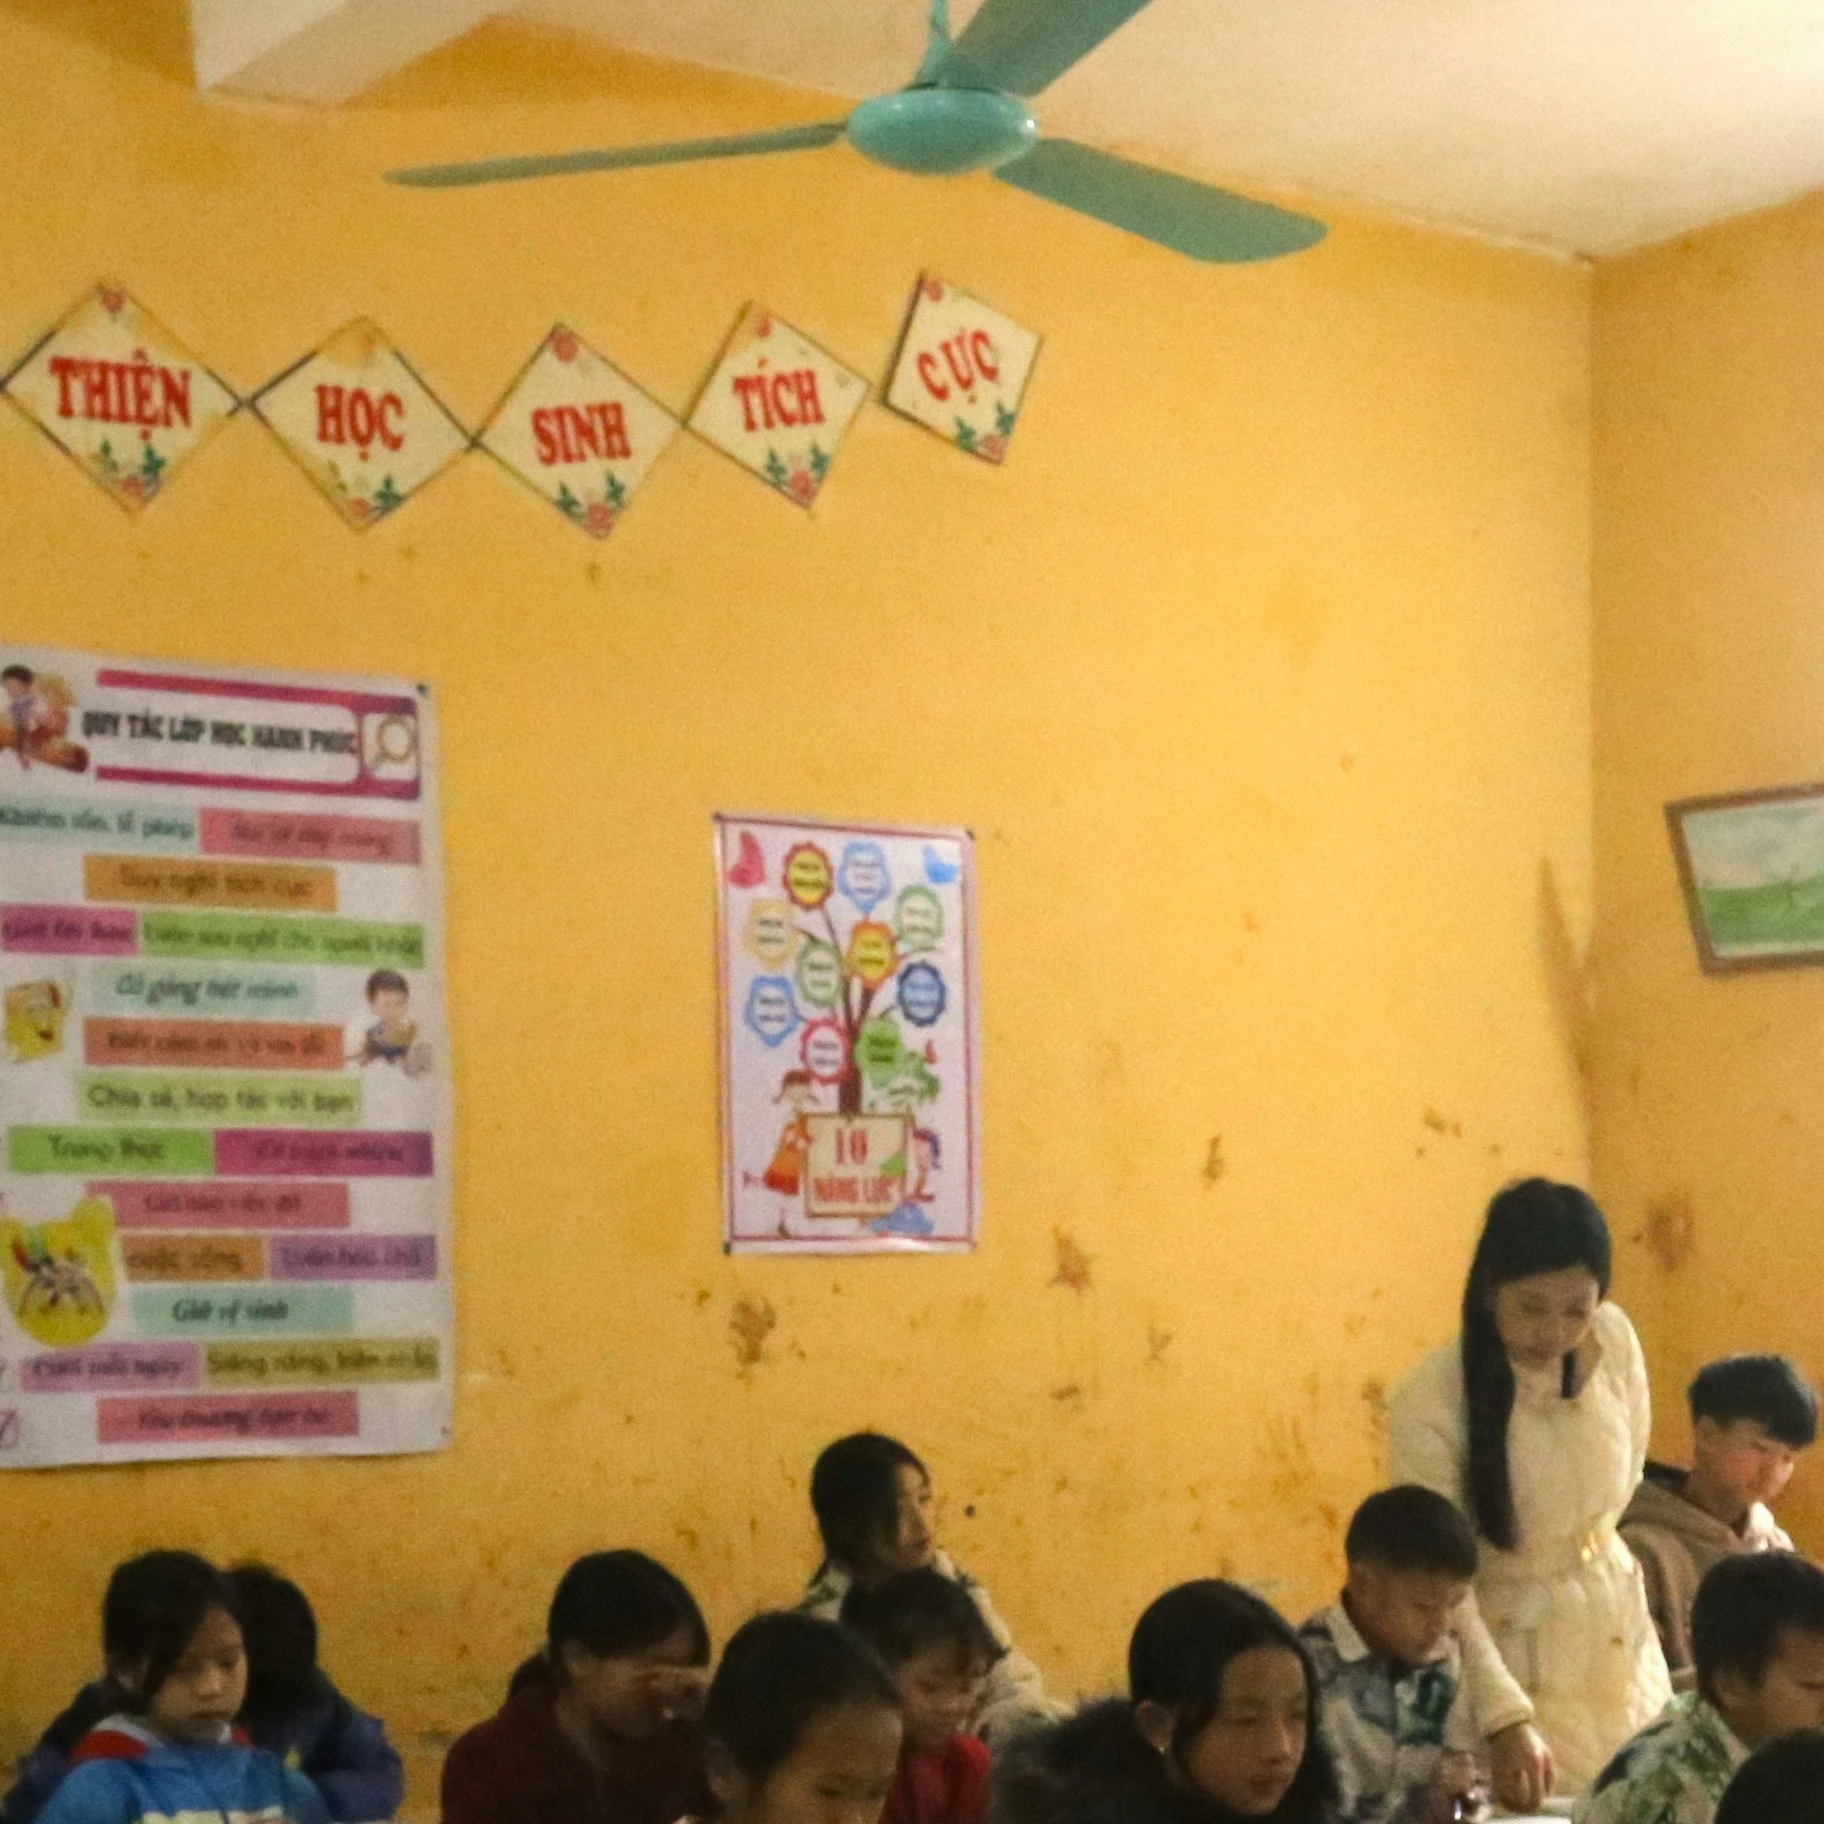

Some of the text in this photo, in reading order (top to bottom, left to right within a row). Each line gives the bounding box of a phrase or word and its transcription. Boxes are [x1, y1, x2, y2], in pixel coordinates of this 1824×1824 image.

[48, 347, 192, 442] THIỆN
[314, 384, 405, 462] HỌC
[531, 401, 632, 466] SINH
[732, 356, 826, 432] TÍCH
[917, 327, 999, 406] CỰC
